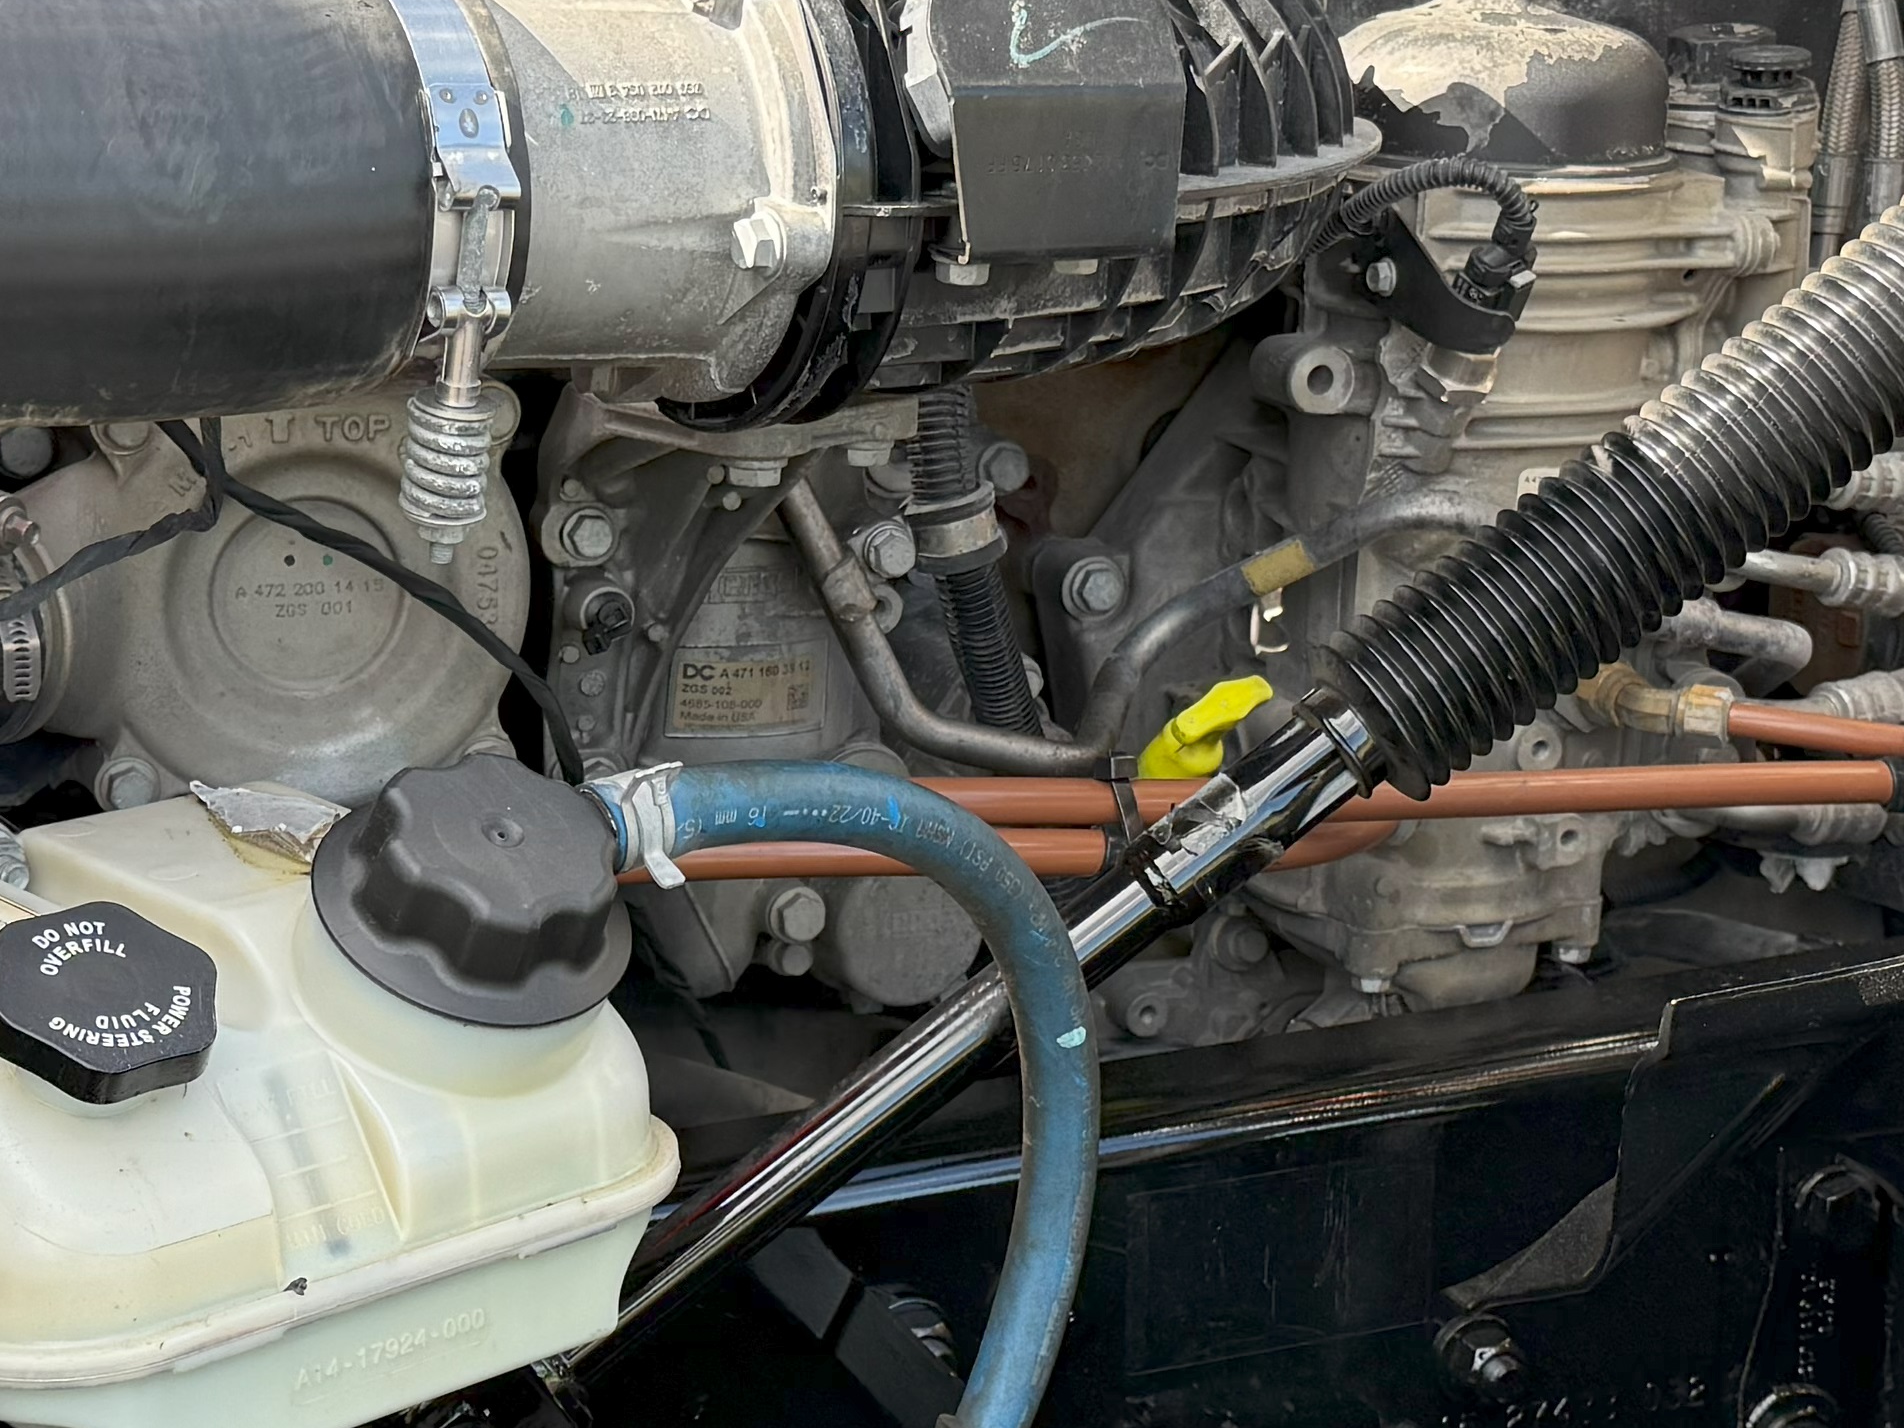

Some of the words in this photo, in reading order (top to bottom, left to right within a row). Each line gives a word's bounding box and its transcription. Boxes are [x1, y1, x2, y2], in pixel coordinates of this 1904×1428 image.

[314, 413, 391, 444] TOP
[254, 582, 285, 598] 472
[682, 663, 716, 681] DC
[732, 666, 754, 679] 471
[680, 684, 708, 695] ZGS
[31, 927, 61, 950] DO
[62, 921, 106, 936] NOT
[39, 938, 127, 977] OVERFILL
[95, 1001, 162, 1030] FLUID
[151, 984, 192, 1036] POWER
[48, 1016, 155, 1048] STEERING
[288, 1306, 491, 1392] A14-17924-000
